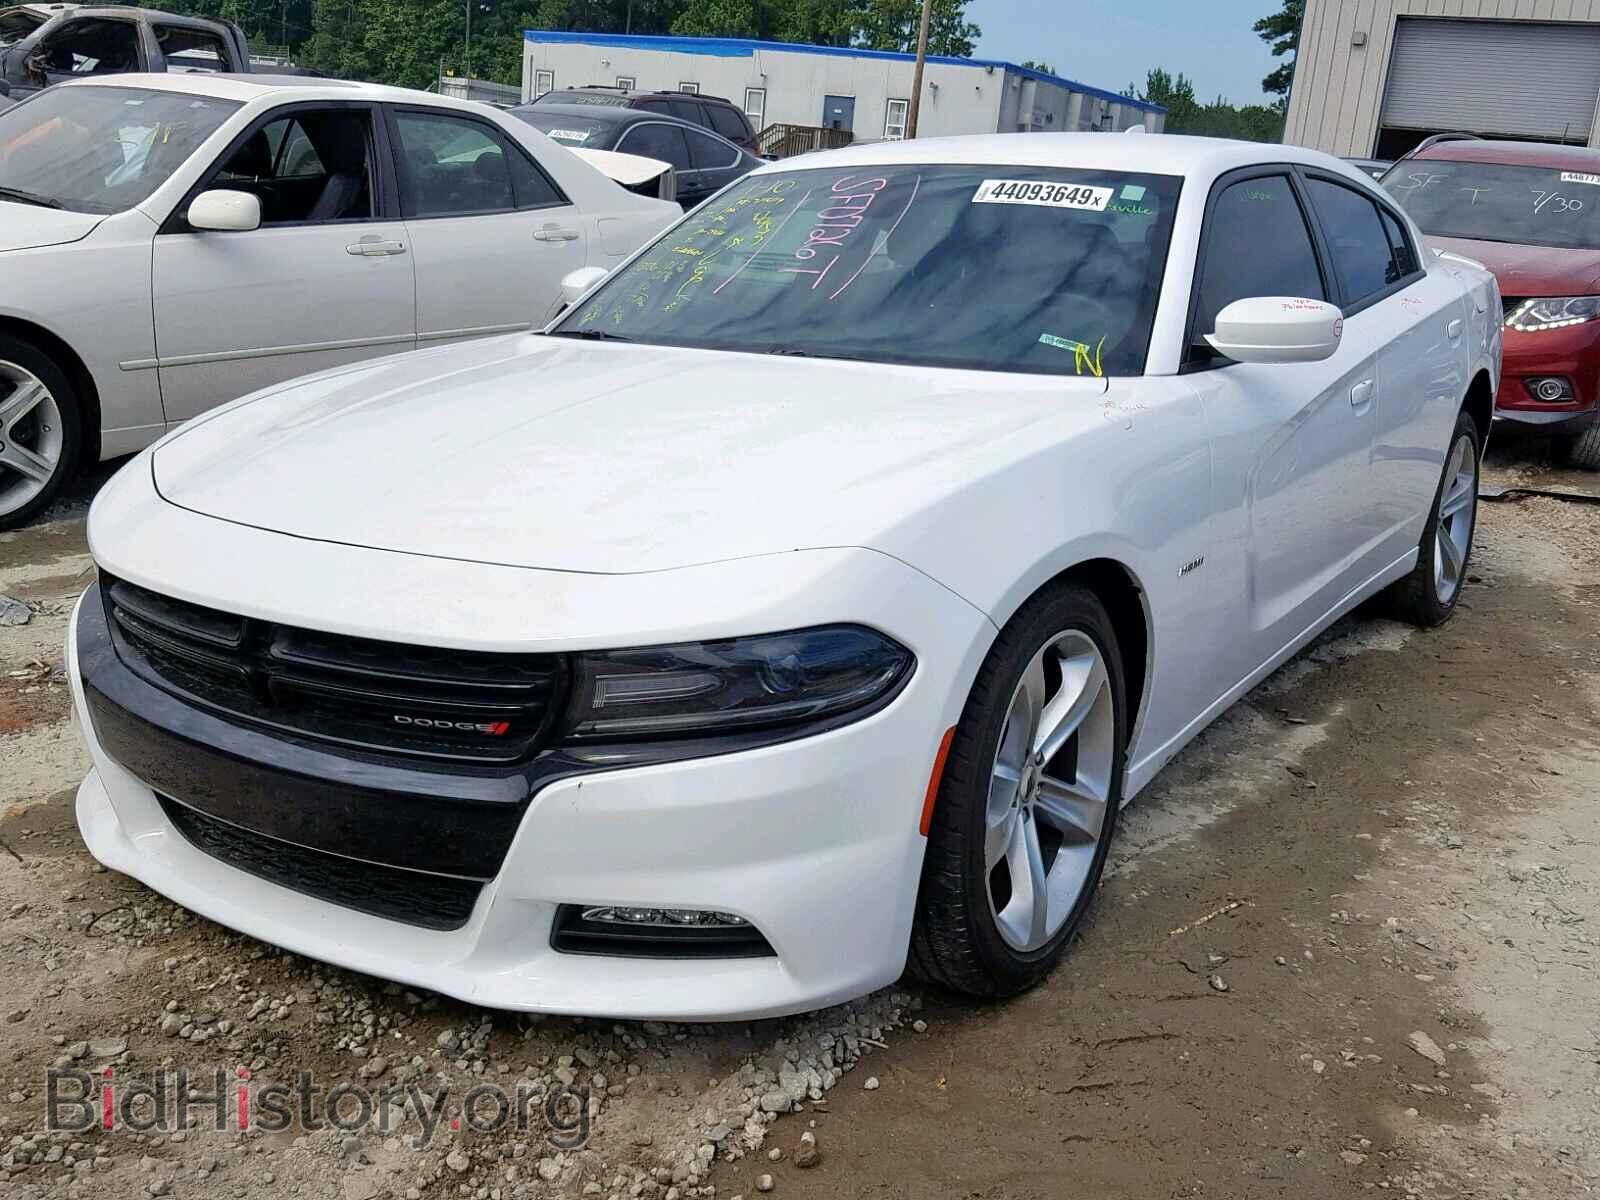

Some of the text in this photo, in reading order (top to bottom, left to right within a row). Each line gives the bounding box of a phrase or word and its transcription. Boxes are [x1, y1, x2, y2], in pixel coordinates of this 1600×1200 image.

[1398, 173, 1583, 215] SF T 7/30
[394, 715, 496, 732] DODGE
